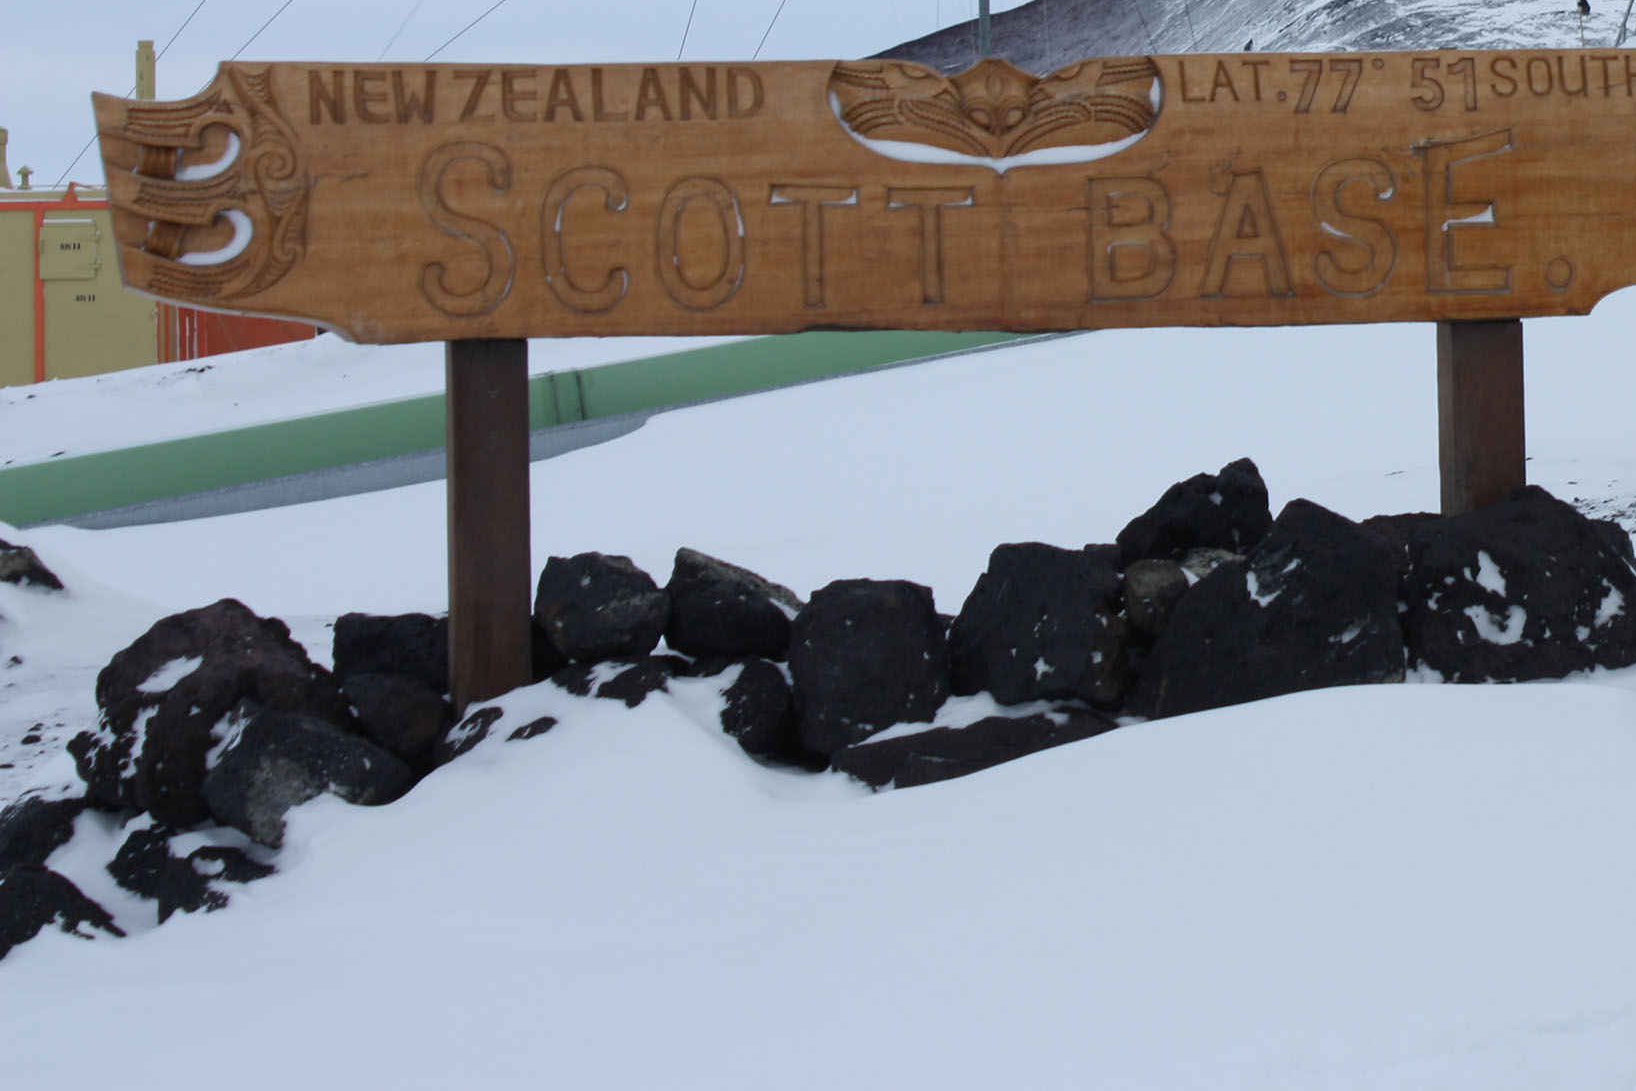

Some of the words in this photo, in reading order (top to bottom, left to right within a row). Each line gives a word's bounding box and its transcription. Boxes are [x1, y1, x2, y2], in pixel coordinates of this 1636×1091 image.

[308, 67, 435, 125] NEW
[452, 65, 766, 123] ZEALAND
[1410, 57, 1479, 112] 51
[417, 140, 975, 317] SCOTT
[1085, 128, 1576, 303] BASE.
